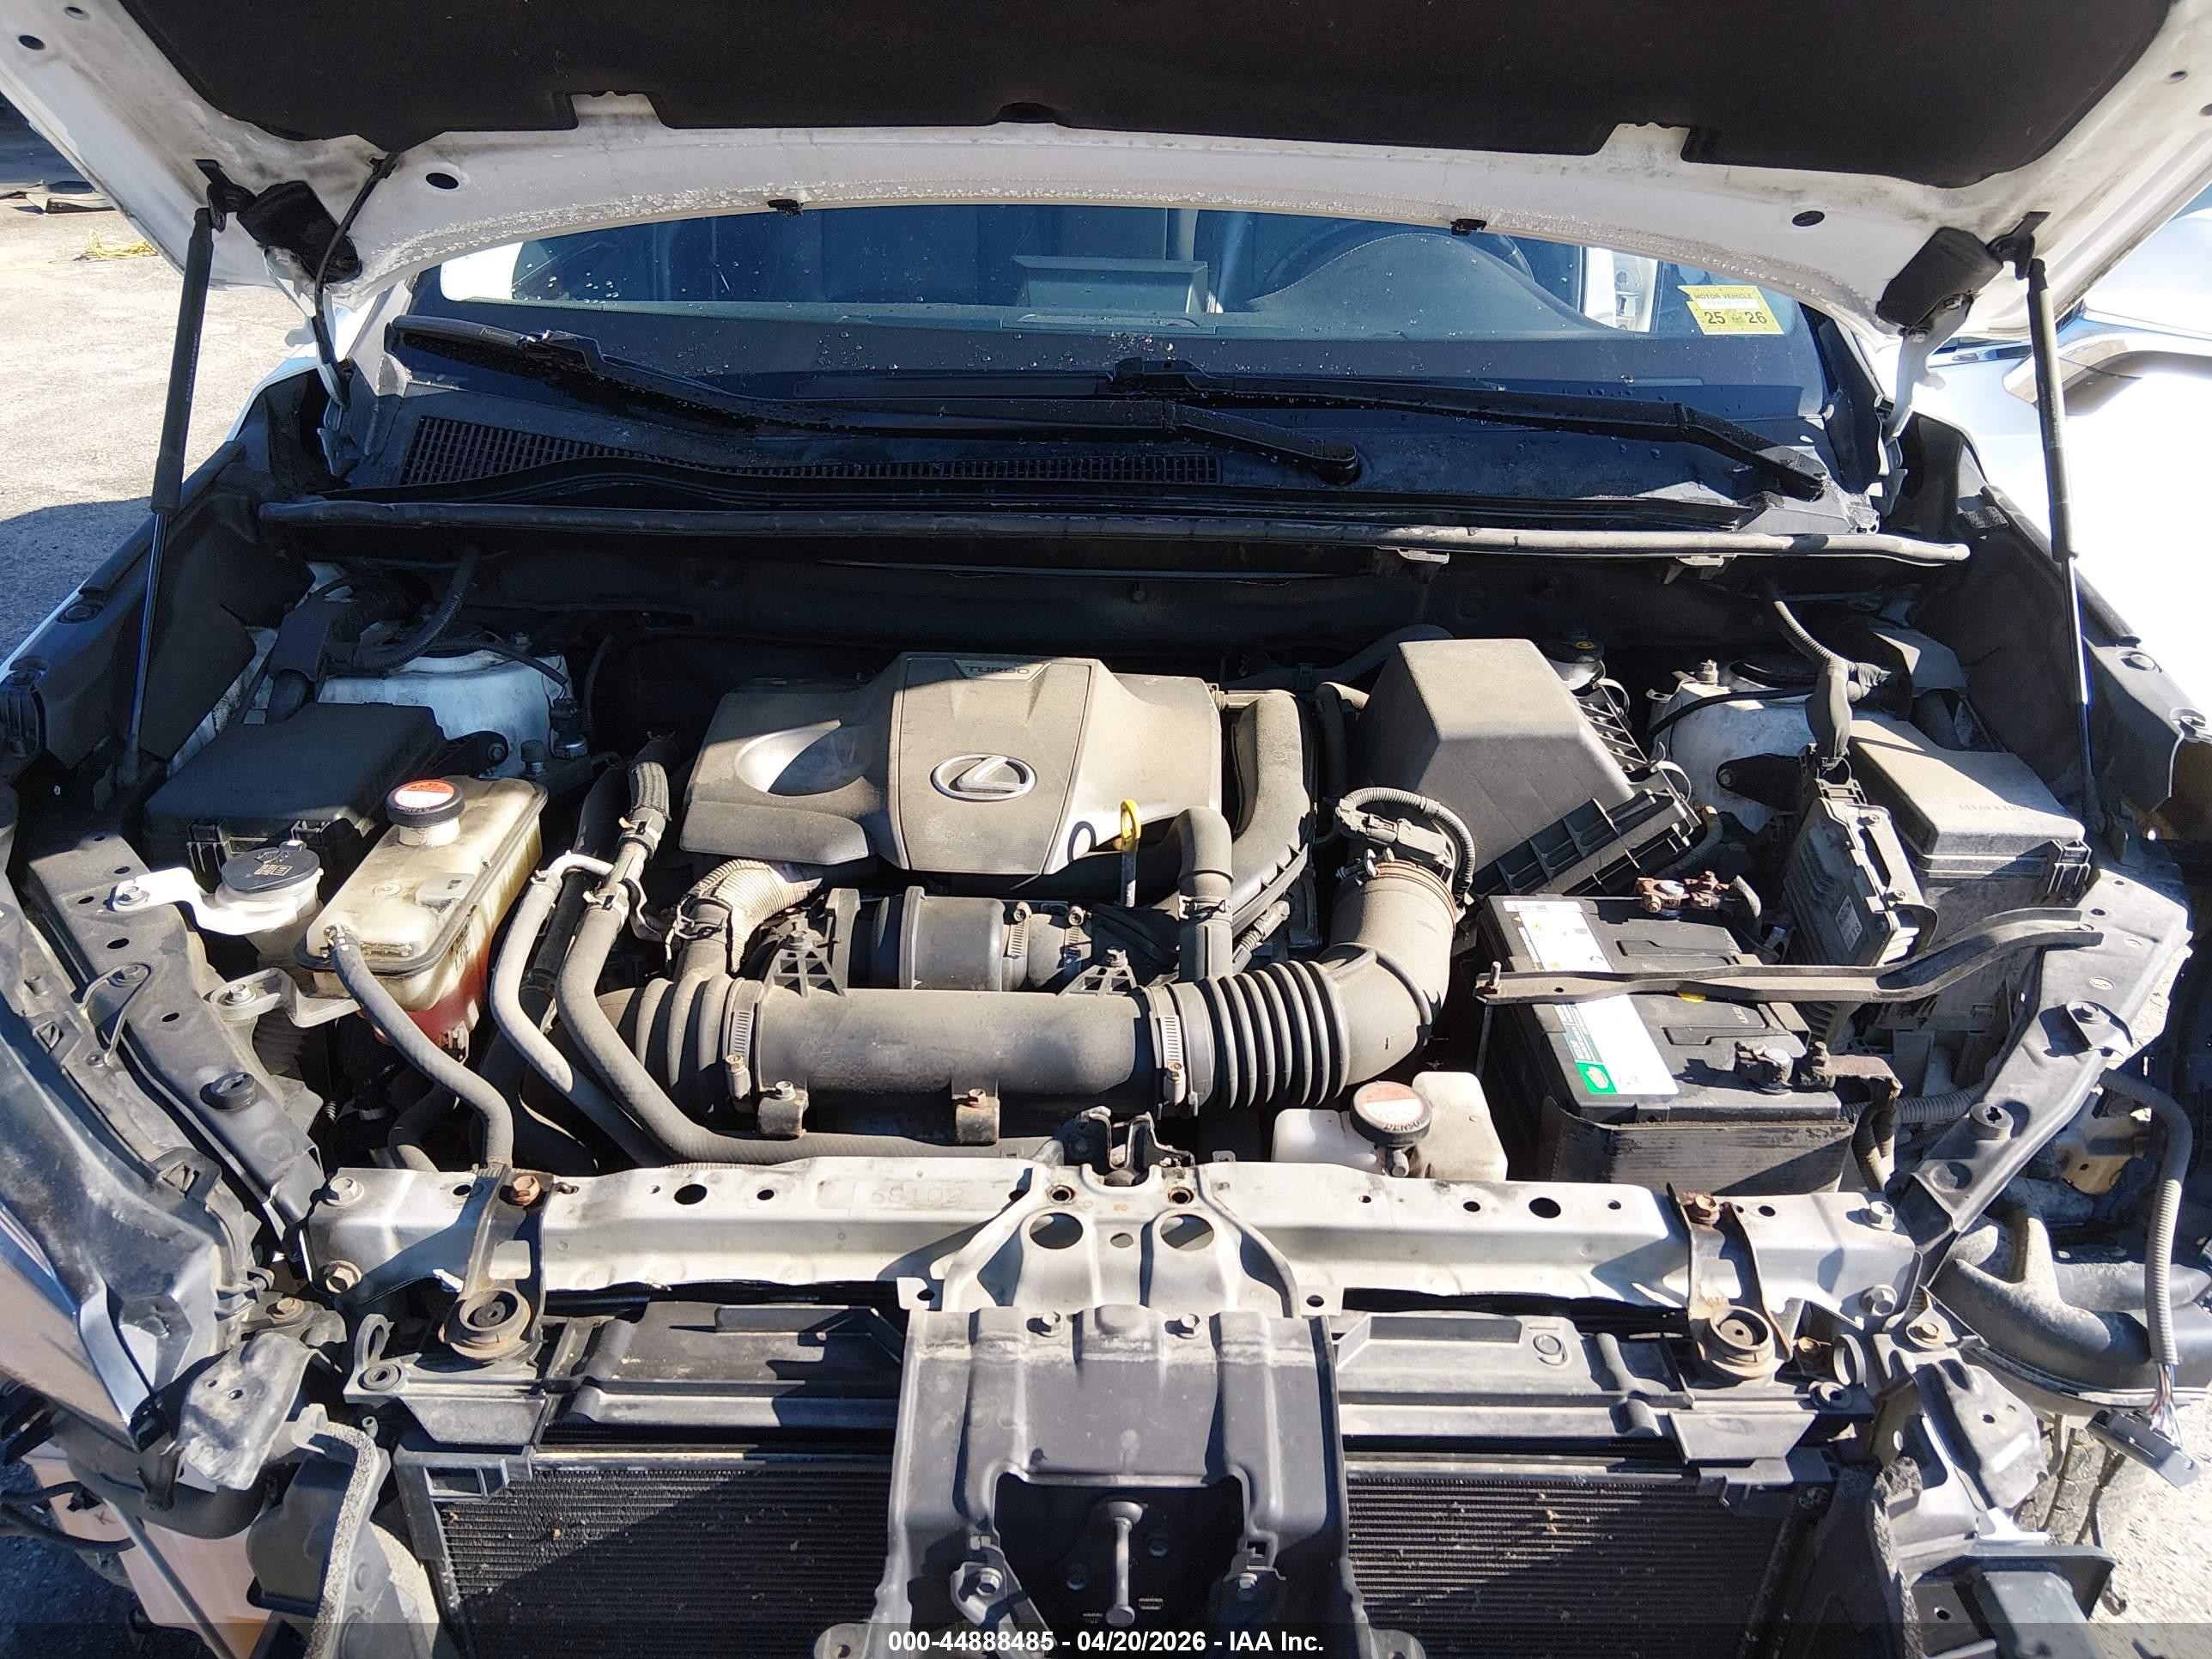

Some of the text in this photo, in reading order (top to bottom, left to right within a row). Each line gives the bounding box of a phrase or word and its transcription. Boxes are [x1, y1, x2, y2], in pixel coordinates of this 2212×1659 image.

[1704, 311, 1726, 325] 25
[1744, 311, 1767, 325] 26
[963, 665, 1030, 675] TURBO
[1382, 1120, 1421, 1132] DENSO
